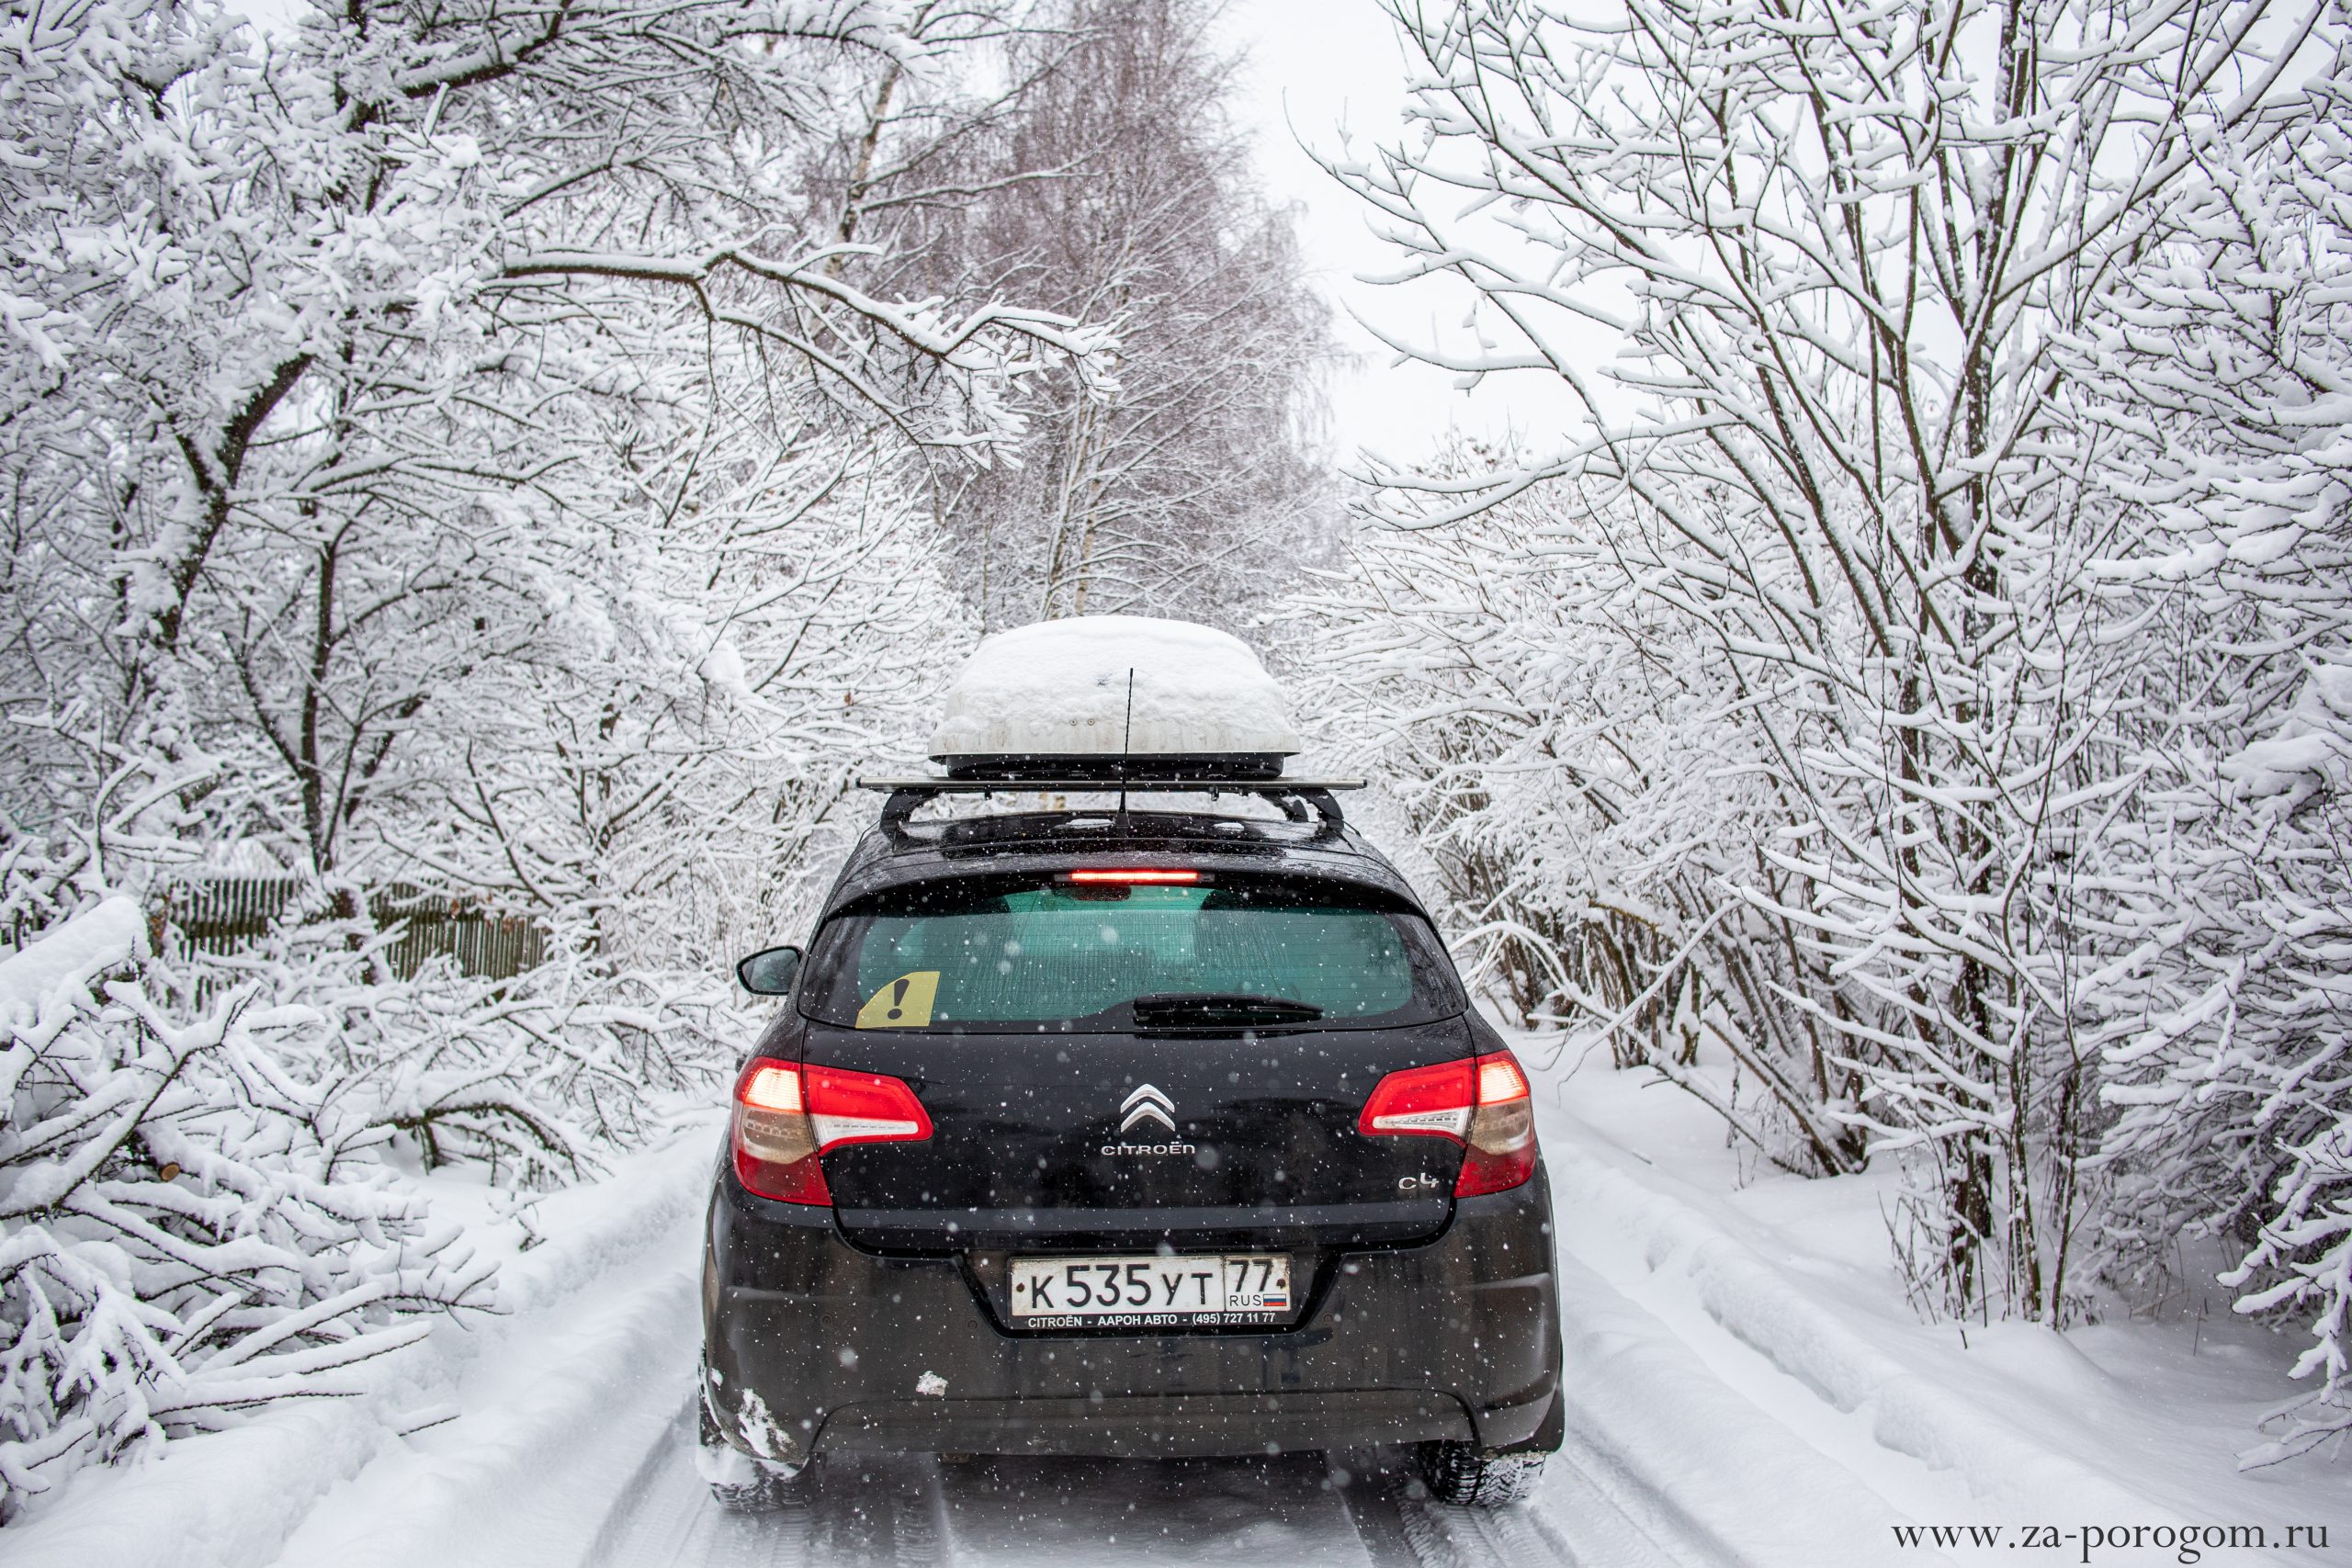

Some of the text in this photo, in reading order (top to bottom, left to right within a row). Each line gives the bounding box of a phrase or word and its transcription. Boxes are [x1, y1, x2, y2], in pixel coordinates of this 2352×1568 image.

[1398, 1172, 1440, 1190] C4
[1229, 1259, 1273, 1292] 77
[1229, 1294, 1262, 1307] RUS
[1027, 1314, 1083, 1328] CITROËN
[1097, 1314, 1142, 1326] ААРОН
[1144, 1314, 1178, 1325] АВТО
[1192, 1313, 1221, 1325] (495)
[1223, 1313, 1244, 1324] 727
[1247, 1313, 1259, 1323] 11
[1262, 1312, 1276, 1323] 77
